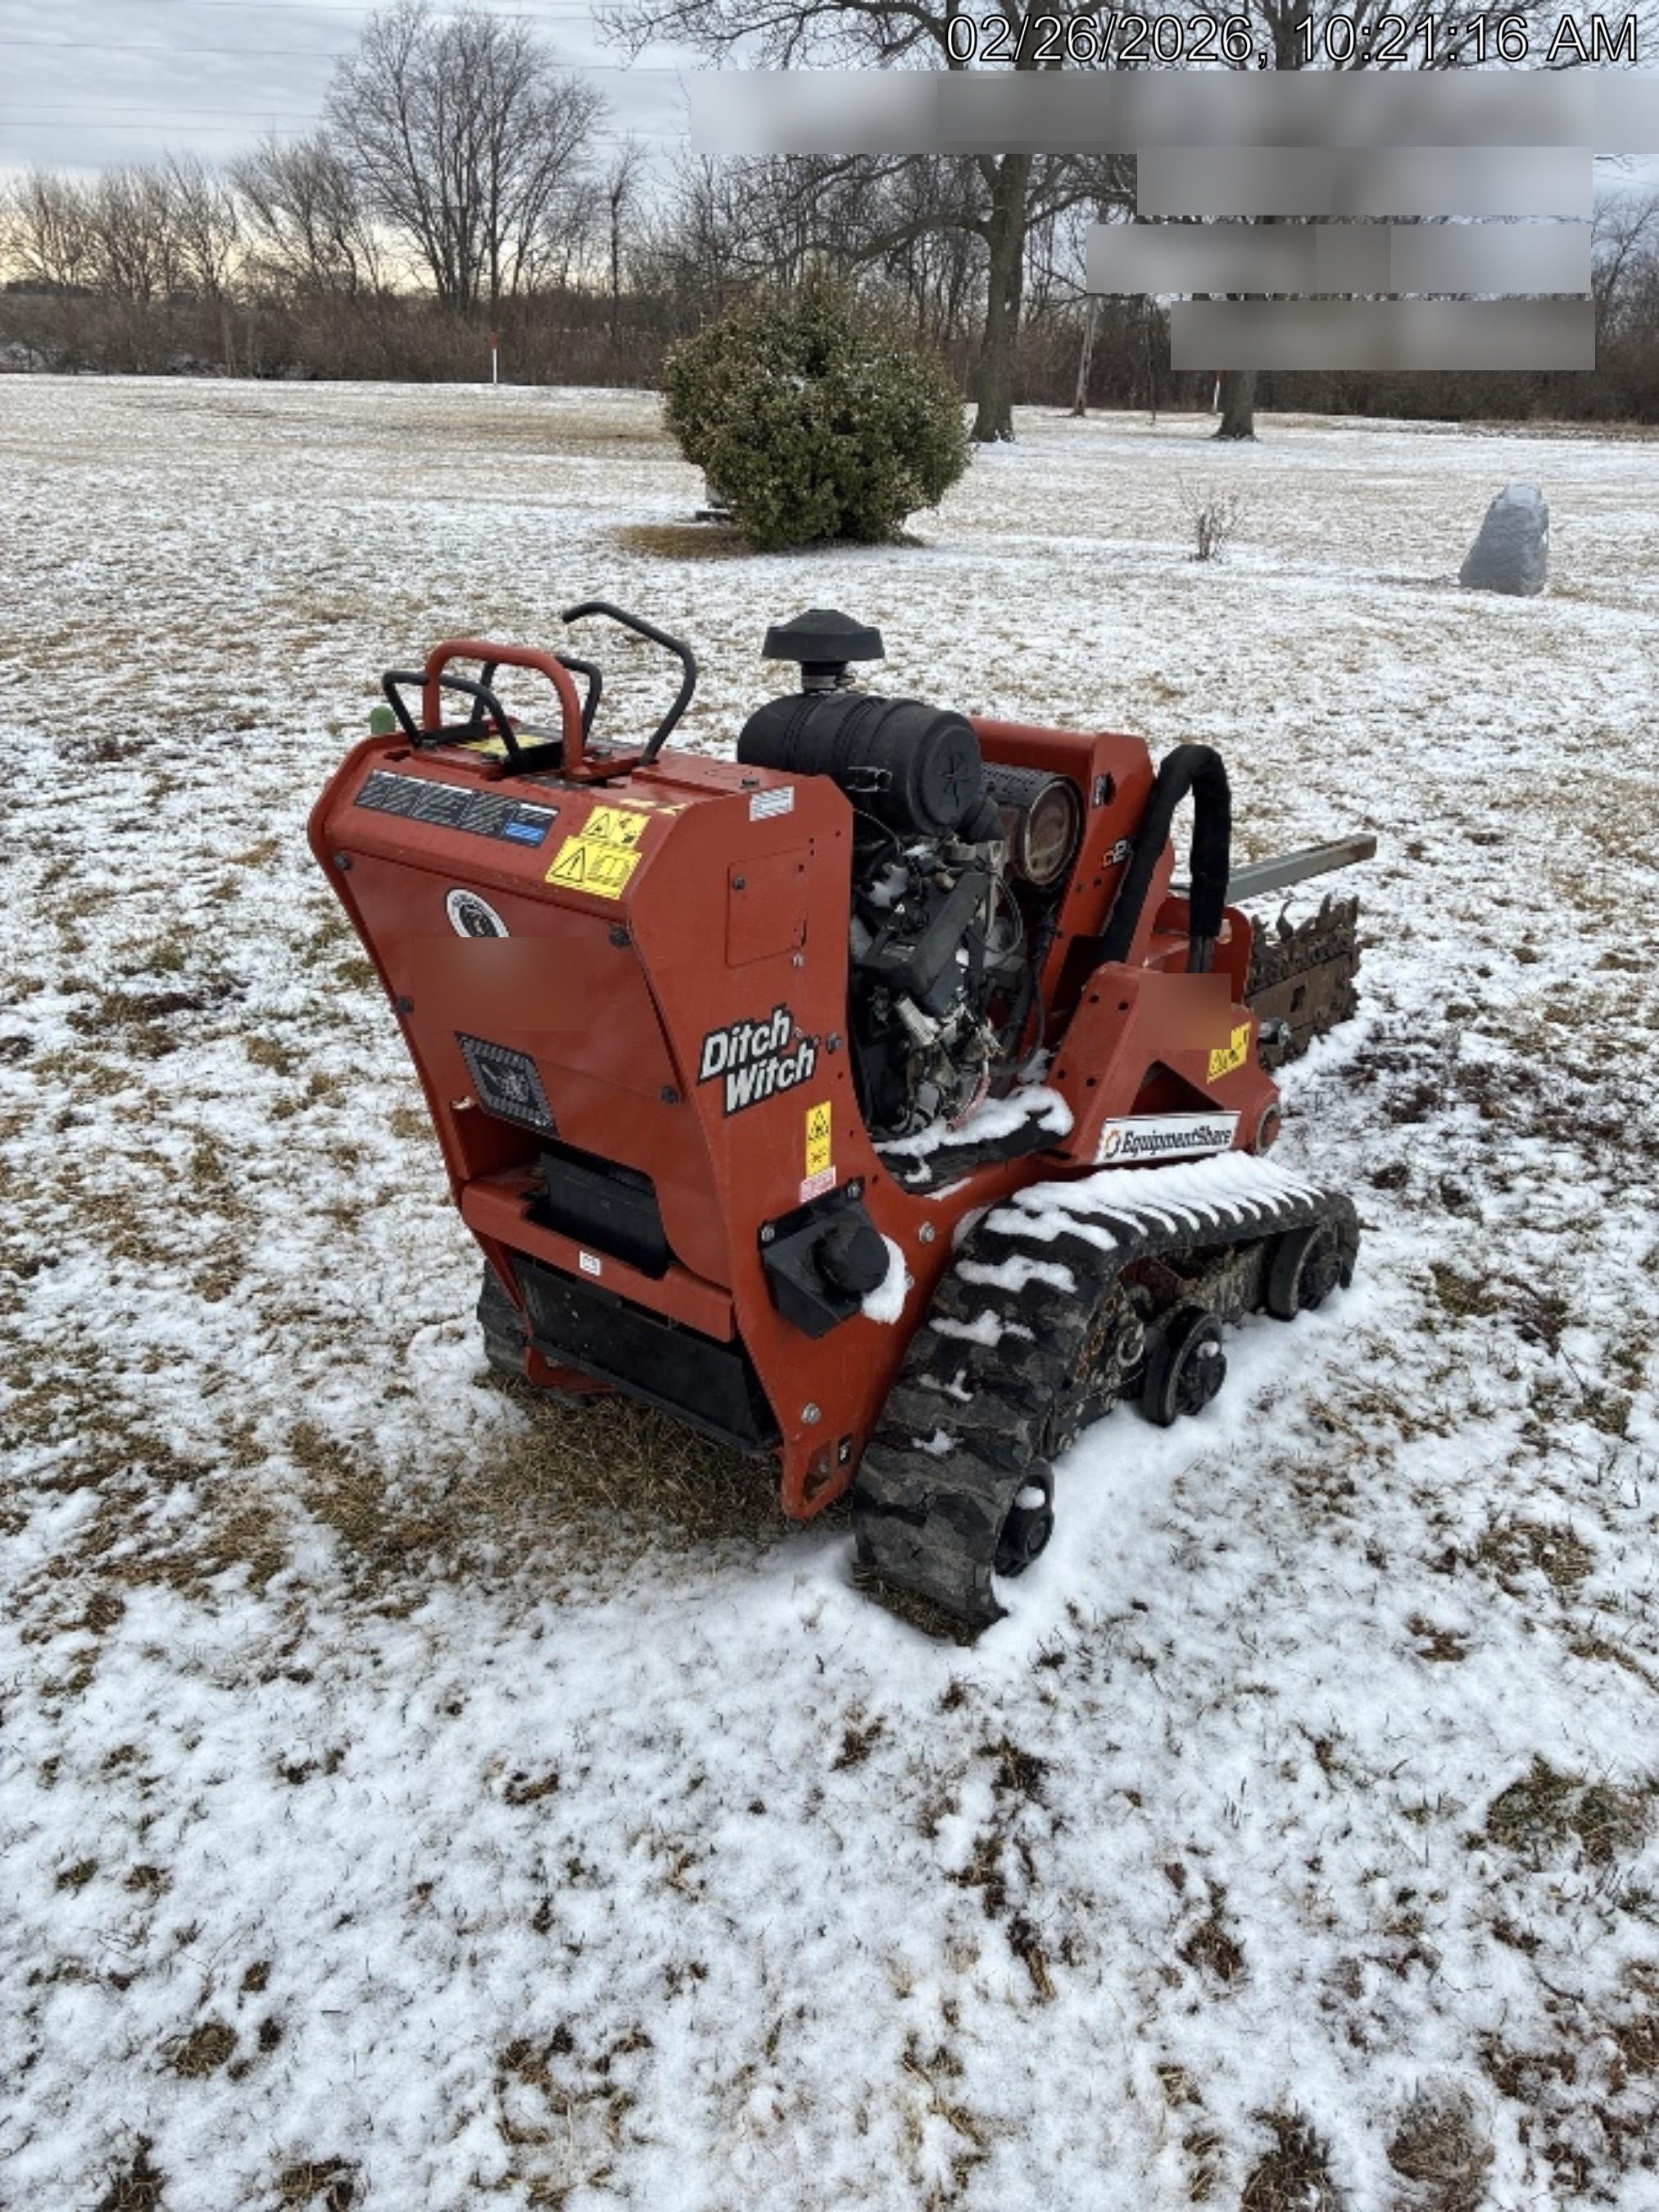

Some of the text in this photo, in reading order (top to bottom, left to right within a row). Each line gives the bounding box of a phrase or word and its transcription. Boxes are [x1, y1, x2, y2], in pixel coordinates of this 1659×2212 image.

[700, 1008, 791, 1081] Ditch
[726, 1041, 815, 1112] Witch
[1122, 1126, 1232, 1155] EquipmentShare
